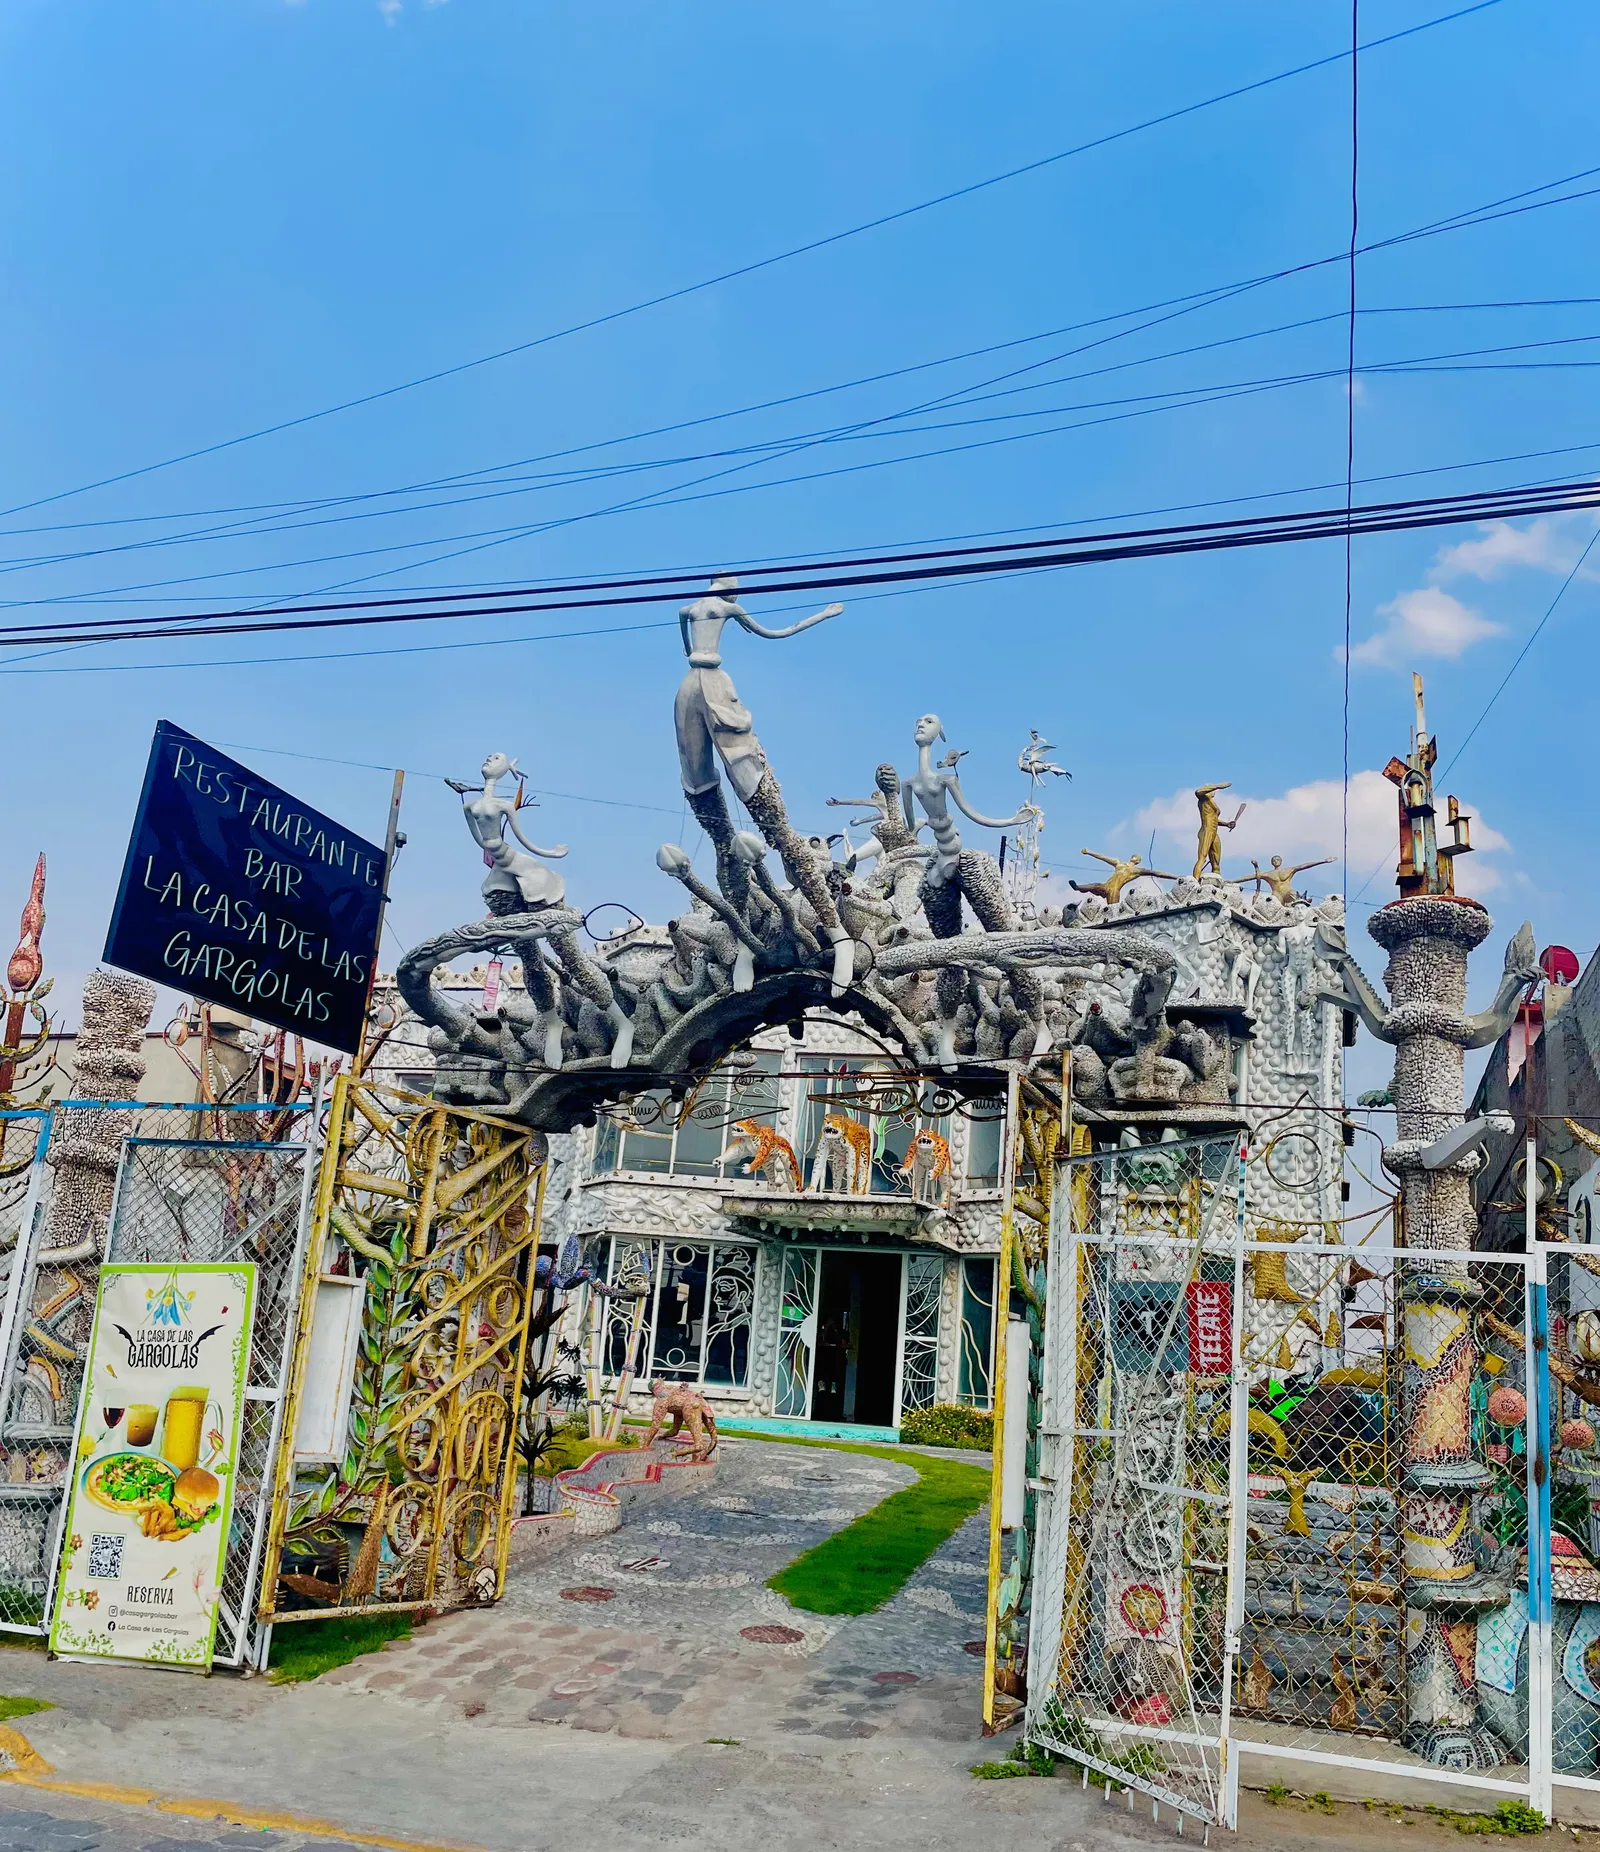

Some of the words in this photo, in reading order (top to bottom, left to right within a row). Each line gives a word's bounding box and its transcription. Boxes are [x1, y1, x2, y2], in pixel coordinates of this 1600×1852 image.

[168, 743, 380, 887] RESTAURANTE
[244, 848, 303, 898] BAR
[143, 855, 182, 907] LA
[193, 883, 267, 944] CASA
[276, 918, 316, 960] DE
[322, 938, 368, 984] LAS
[164, 930, 334, 1022] GARGOLAS
[127, 1343, 199, 1369] GARGOLAS
[136, 1330, 145, 1342] LA
[147, 1330, 165, 1342] CASA
[167, 1330, 177, 1342] DE
[178, 1330, 193, 1342] LAS
[1197, 1288, 1223, 1368] TECATE
[127, 1585, 174, 1605] RESERVA
